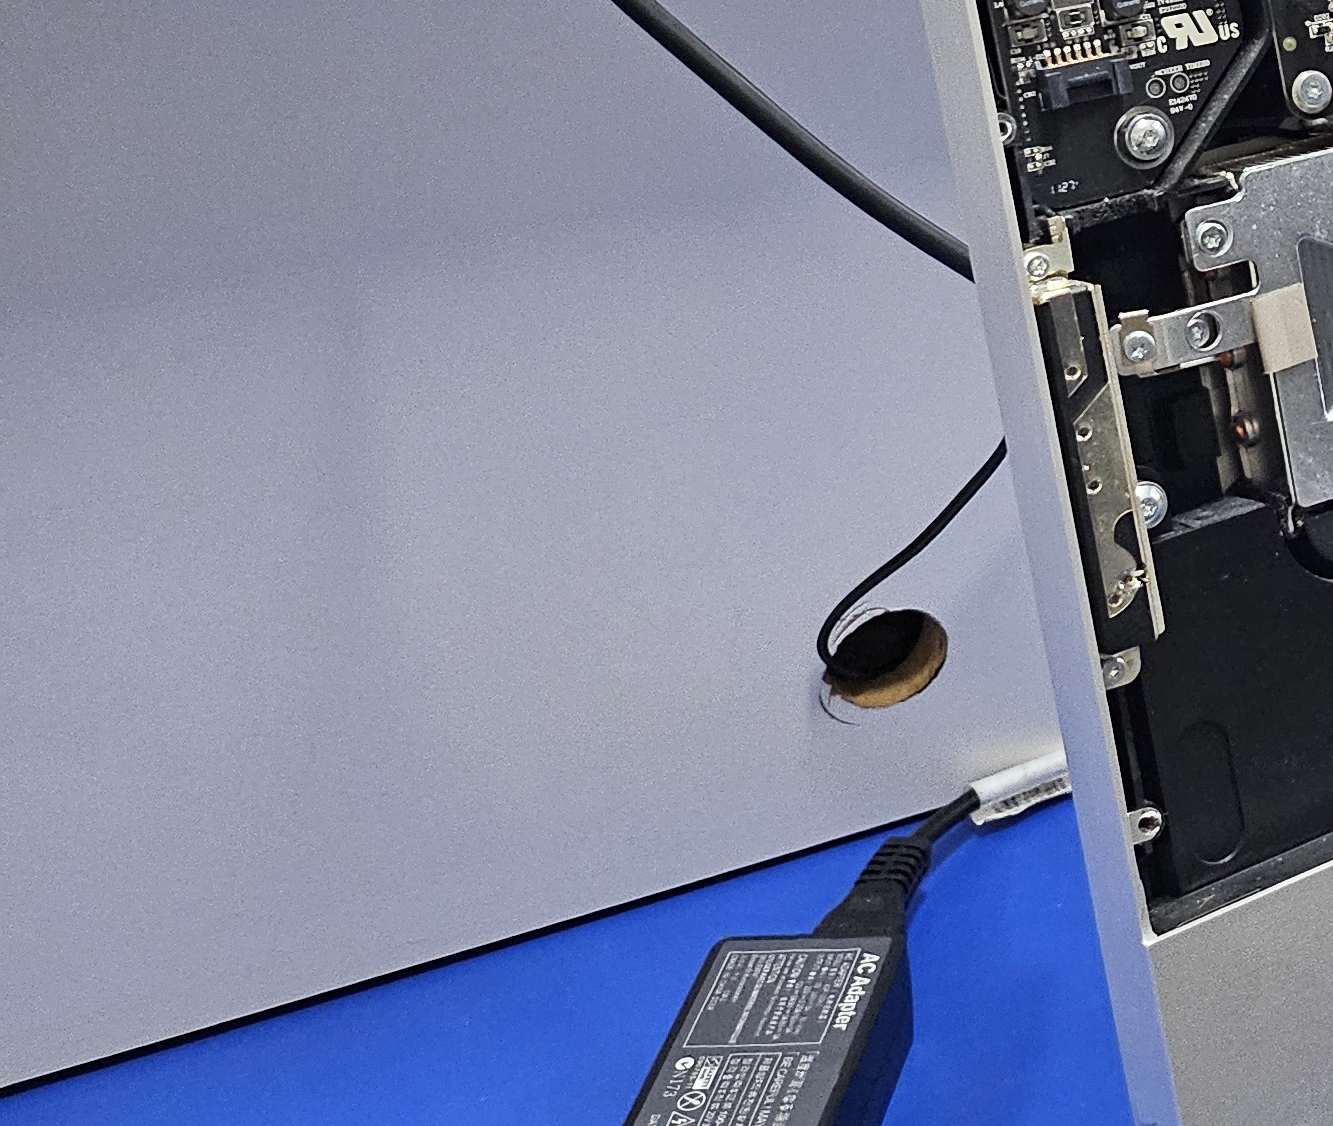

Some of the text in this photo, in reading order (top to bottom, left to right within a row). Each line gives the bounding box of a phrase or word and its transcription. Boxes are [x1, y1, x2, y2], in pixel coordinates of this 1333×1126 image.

[1218, 22, 1240, 41] US
[832, 952, 881, 1031] AC Adapter
